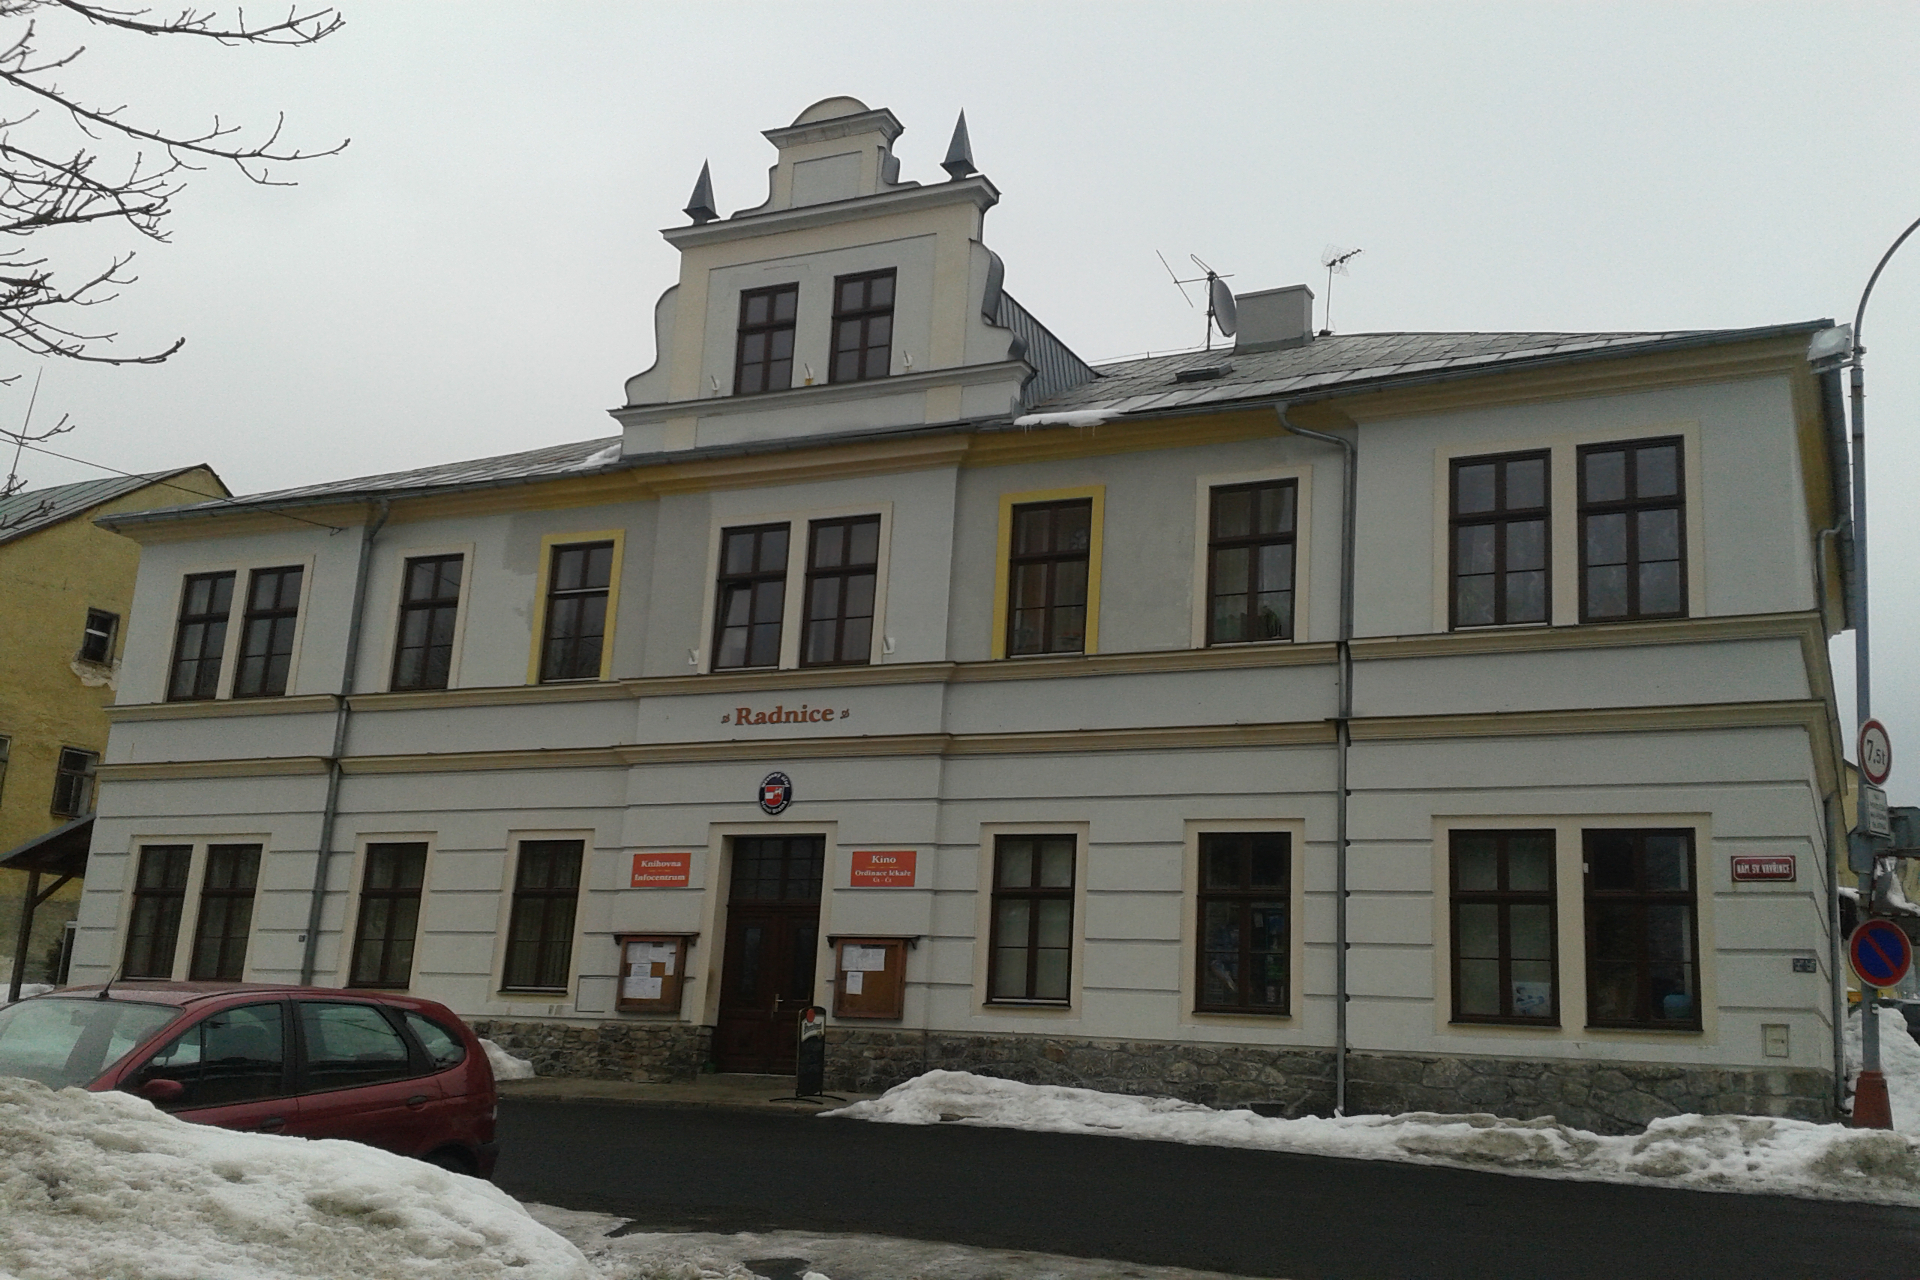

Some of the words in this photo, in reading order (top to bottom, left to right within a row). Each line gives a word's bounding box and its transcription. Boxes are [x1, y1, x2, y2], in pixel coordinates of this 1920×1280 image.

[735, 704, 835, 726] Radnice
[641, 860, 682, 868] Knihovna
[871, 855, 897, 864] Kino
